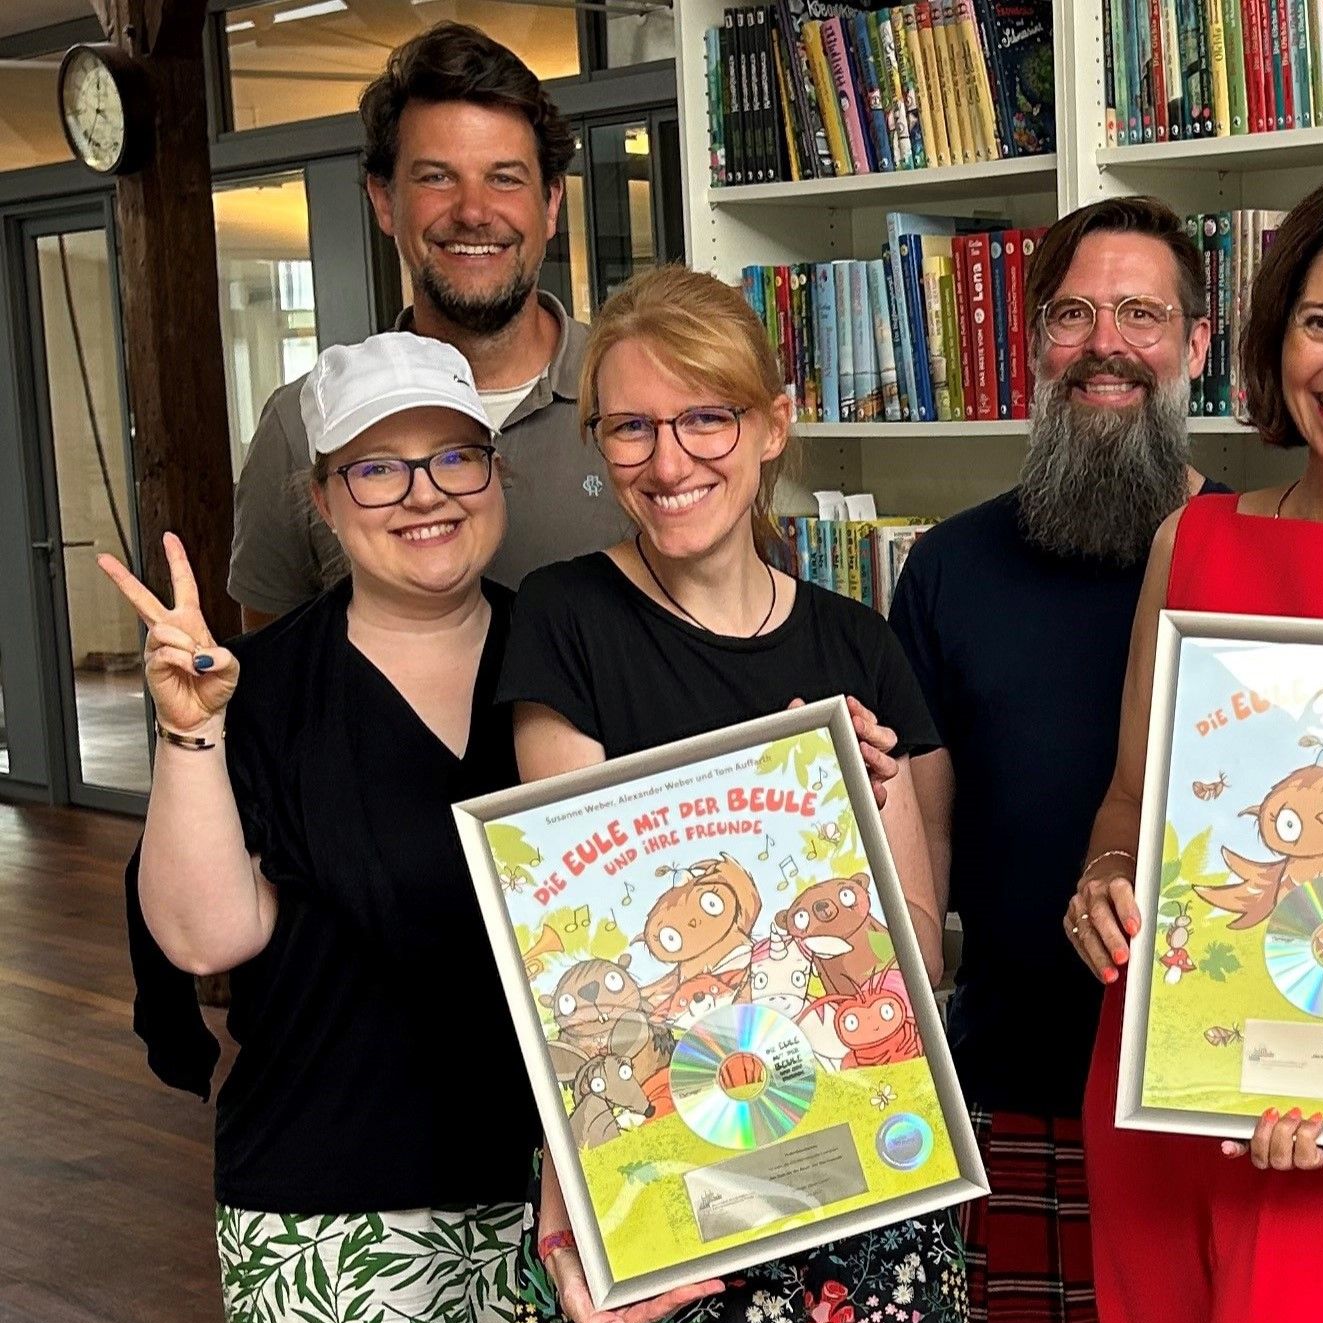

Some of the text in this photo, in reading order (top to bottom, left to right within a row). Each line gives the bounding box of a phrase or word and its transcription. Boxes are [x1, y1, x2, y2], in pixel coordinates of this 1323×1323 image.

[970, 262, 984, 302] Lena
[545, 808, 583, 826] Susanne
[617, 786, 664, 804] Alexander
[664, 776, 694, 792] Weber
[695, 773, 713, 785] und
[714, 766, 733, 778] Tom
[562, 819, 629, 877] EULE
[679, 796, 721, 819] DER
[727, 787, 818, 818] BEULE
[603, 848, 638, 876] UND
[685, 819, 763, 842] FREUNDE
